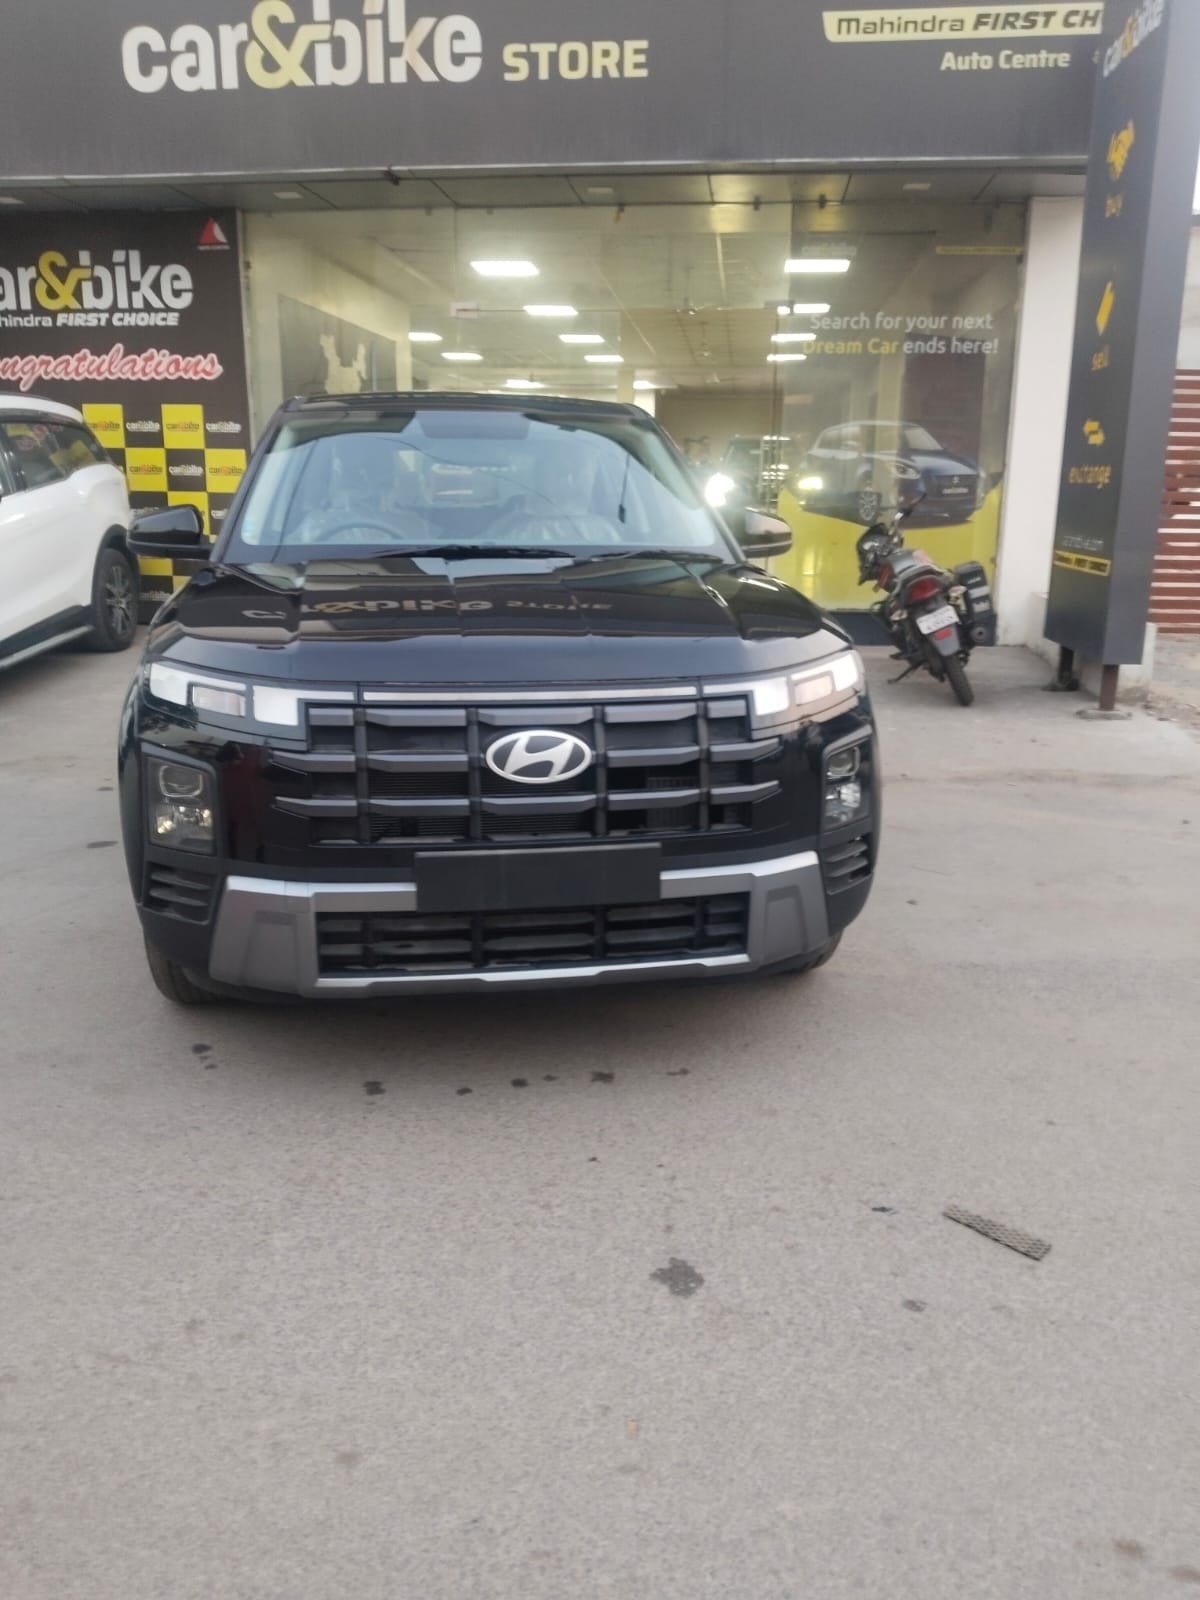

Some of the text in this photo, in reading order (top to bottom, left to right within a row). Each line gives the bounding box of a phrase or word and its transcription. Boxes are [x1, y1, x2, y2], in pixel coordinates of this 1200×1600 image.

[837, 9, 1102, 35] Mahindra FIRST CH
[121, 0, 650, 92] car&bike STORE
[940, 49, 1071, 71] Auto Centre
[56, 312, 110, 327] FIRST
[112, 312, 181, 326] CHOICE
[810, 312, 993, 332] Search for your next
[803, 337, 999, 354] Dream Car ends here!
